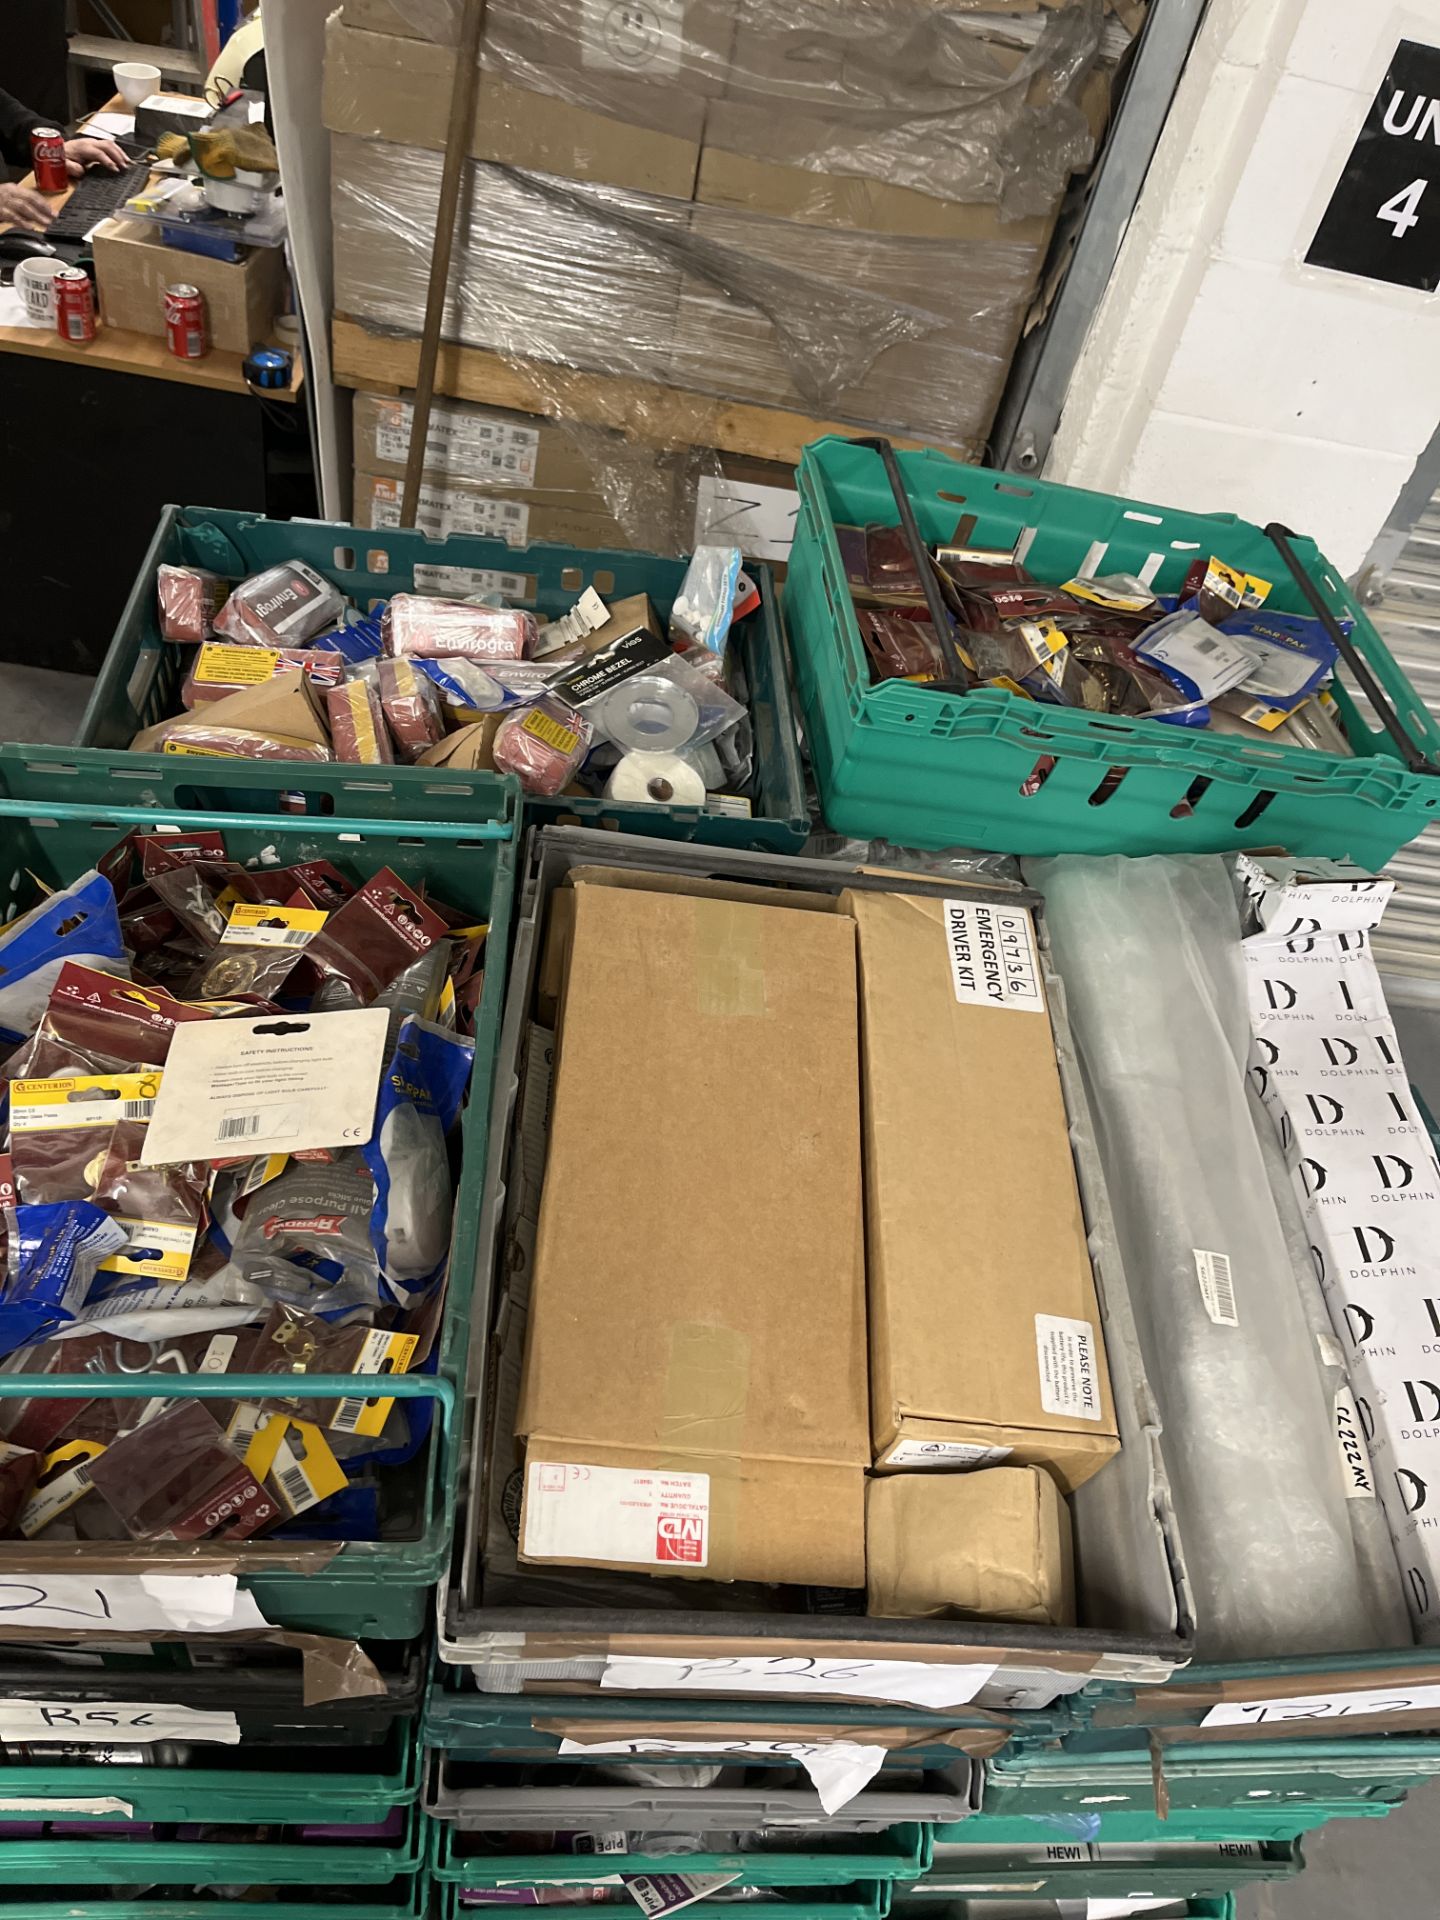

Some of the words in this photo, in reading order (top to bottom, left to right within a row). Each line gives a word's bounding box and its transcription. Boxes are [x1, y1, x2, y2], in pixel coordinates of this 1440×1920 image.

[1376, 178, 1429, 239] 4
[571, 670, 606, 691] CHROME
[605, 658, 632, 673] BEZEL
[1331, 894, 1384, 903] DOLPHIN
[950, 908, 971, 962] DRIVER
[975, 908, 1004, 1002] EMERGENCY
[1279, 955, 1334, 964] DOLPHIN
[958, 966, 976, 991] KIT
[1260, 1012, 1314, 1021] DOLPHIN
[266, 1046, 314, 1054] INSTRUCTIONS
[1320, 1068, 1379, 1077] DOLPHIN
[27, 1081, 73, 1090] CENTURION
[1305, 1128, 1365, 1136] DOLPHIN
[289, 1196, 346, 1211] Purpose
[1370, 1193, 1435, 1203] DOLPHIN
[1350, 1266, 1417, 1279] DOLPHIN
[1077, 1334, 1091, 1374] PLEASE
[1081, 1377, 1093, 1409] NOTE
[1047, 1846, 1082, 1861] HEWI
[1219, 1843, 1254, 1858] HEWI
